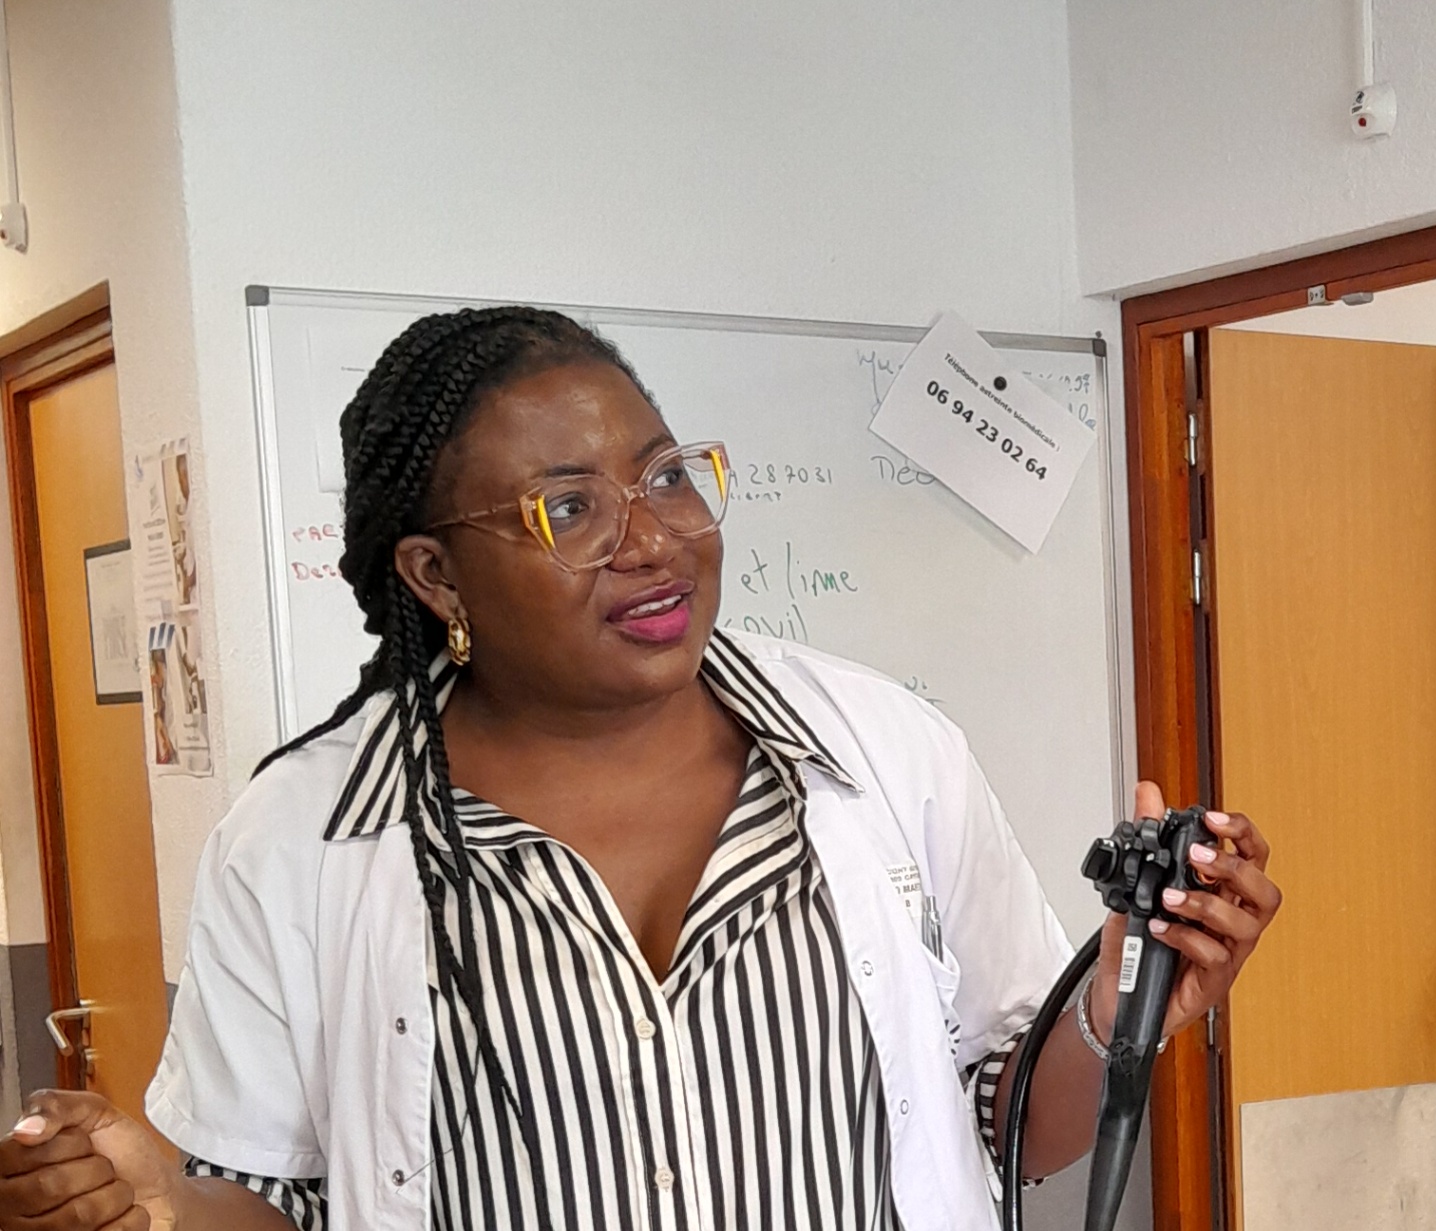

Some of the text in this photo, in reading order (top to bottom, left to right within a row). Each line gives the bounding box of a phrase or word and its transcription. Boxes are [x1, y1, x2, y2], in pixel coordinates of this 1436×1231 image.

[979, 385, 1013, 414] astreinte
[926, 380, 1048, 481] 06 94 23 02 64
[741, 548, 769, 594] et
